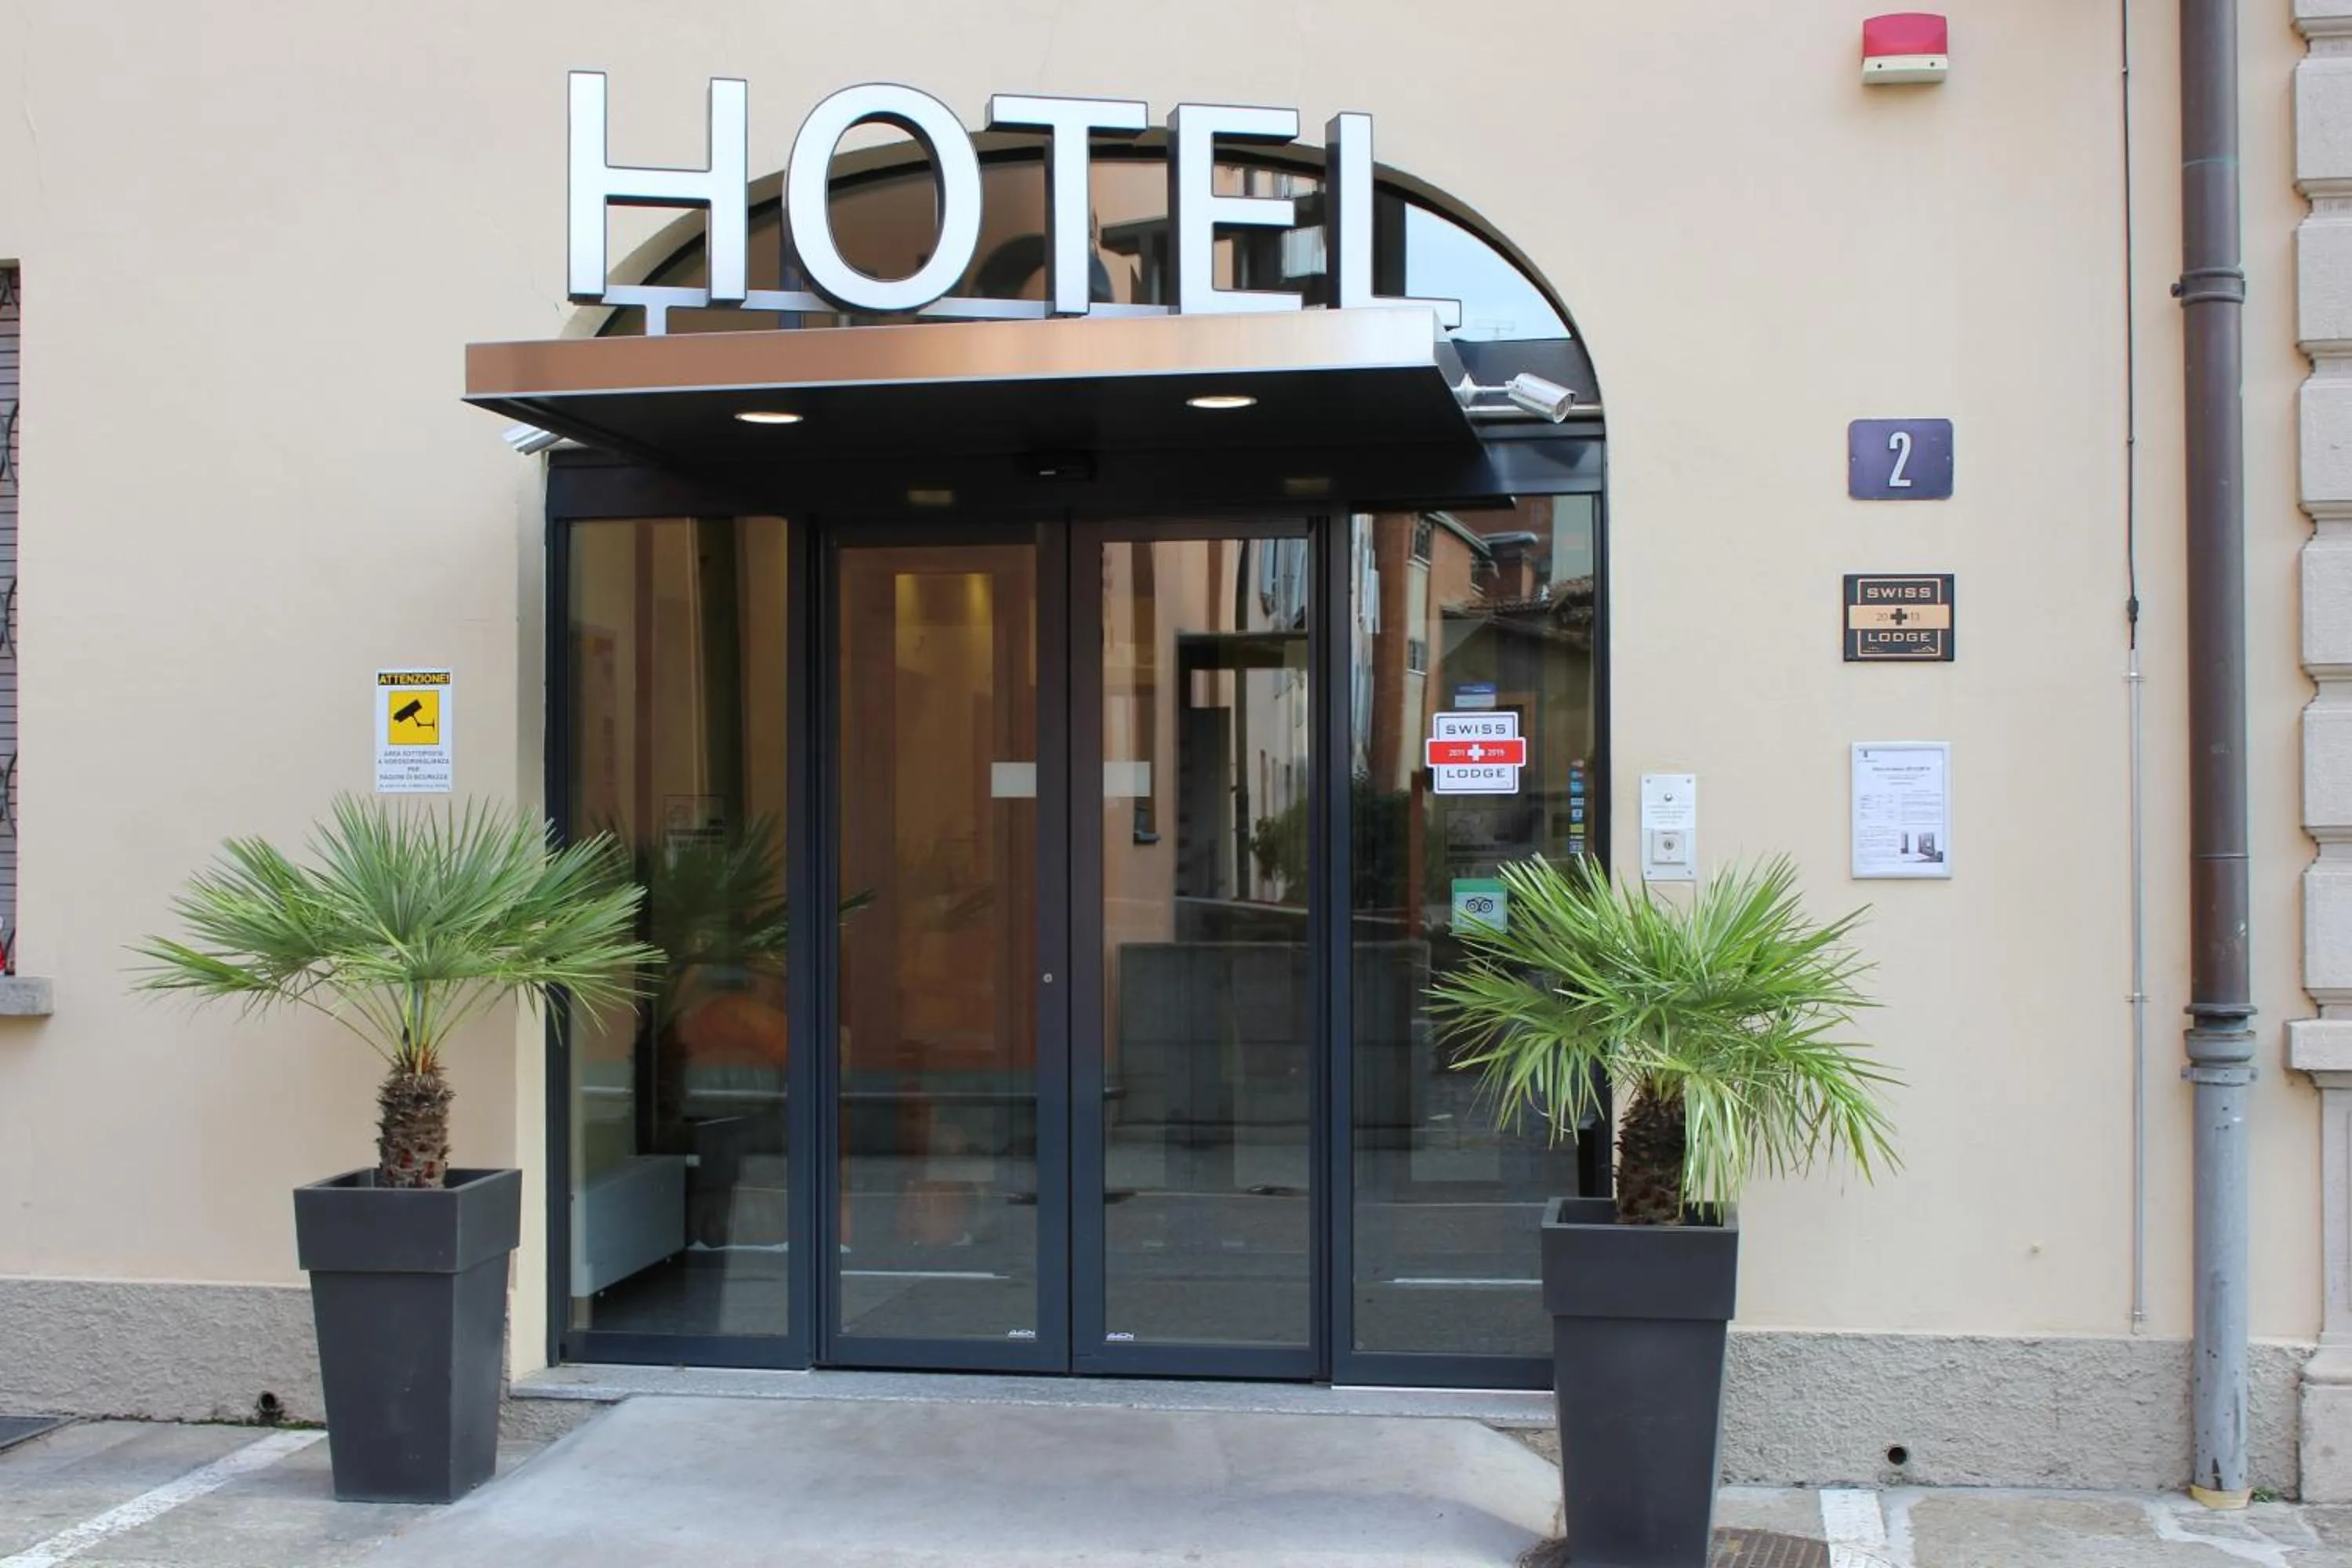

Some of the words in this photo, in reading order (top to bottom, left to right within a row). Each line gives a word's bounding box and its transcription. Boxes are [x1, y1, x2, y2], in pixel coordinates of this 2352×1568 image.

[568, 71, 1461, 329] HOTEL
[1889, 431, 1911, 487] 2
[1867, 587, 1931, 598] SWISS
[1867, 632, 1931, 642] LODGE
[379, 673, 449, 684] ATTENZIONE!
[1445, 724, 1506, 735] SWISS
[1446, 768, 1506, 779] LODGE
